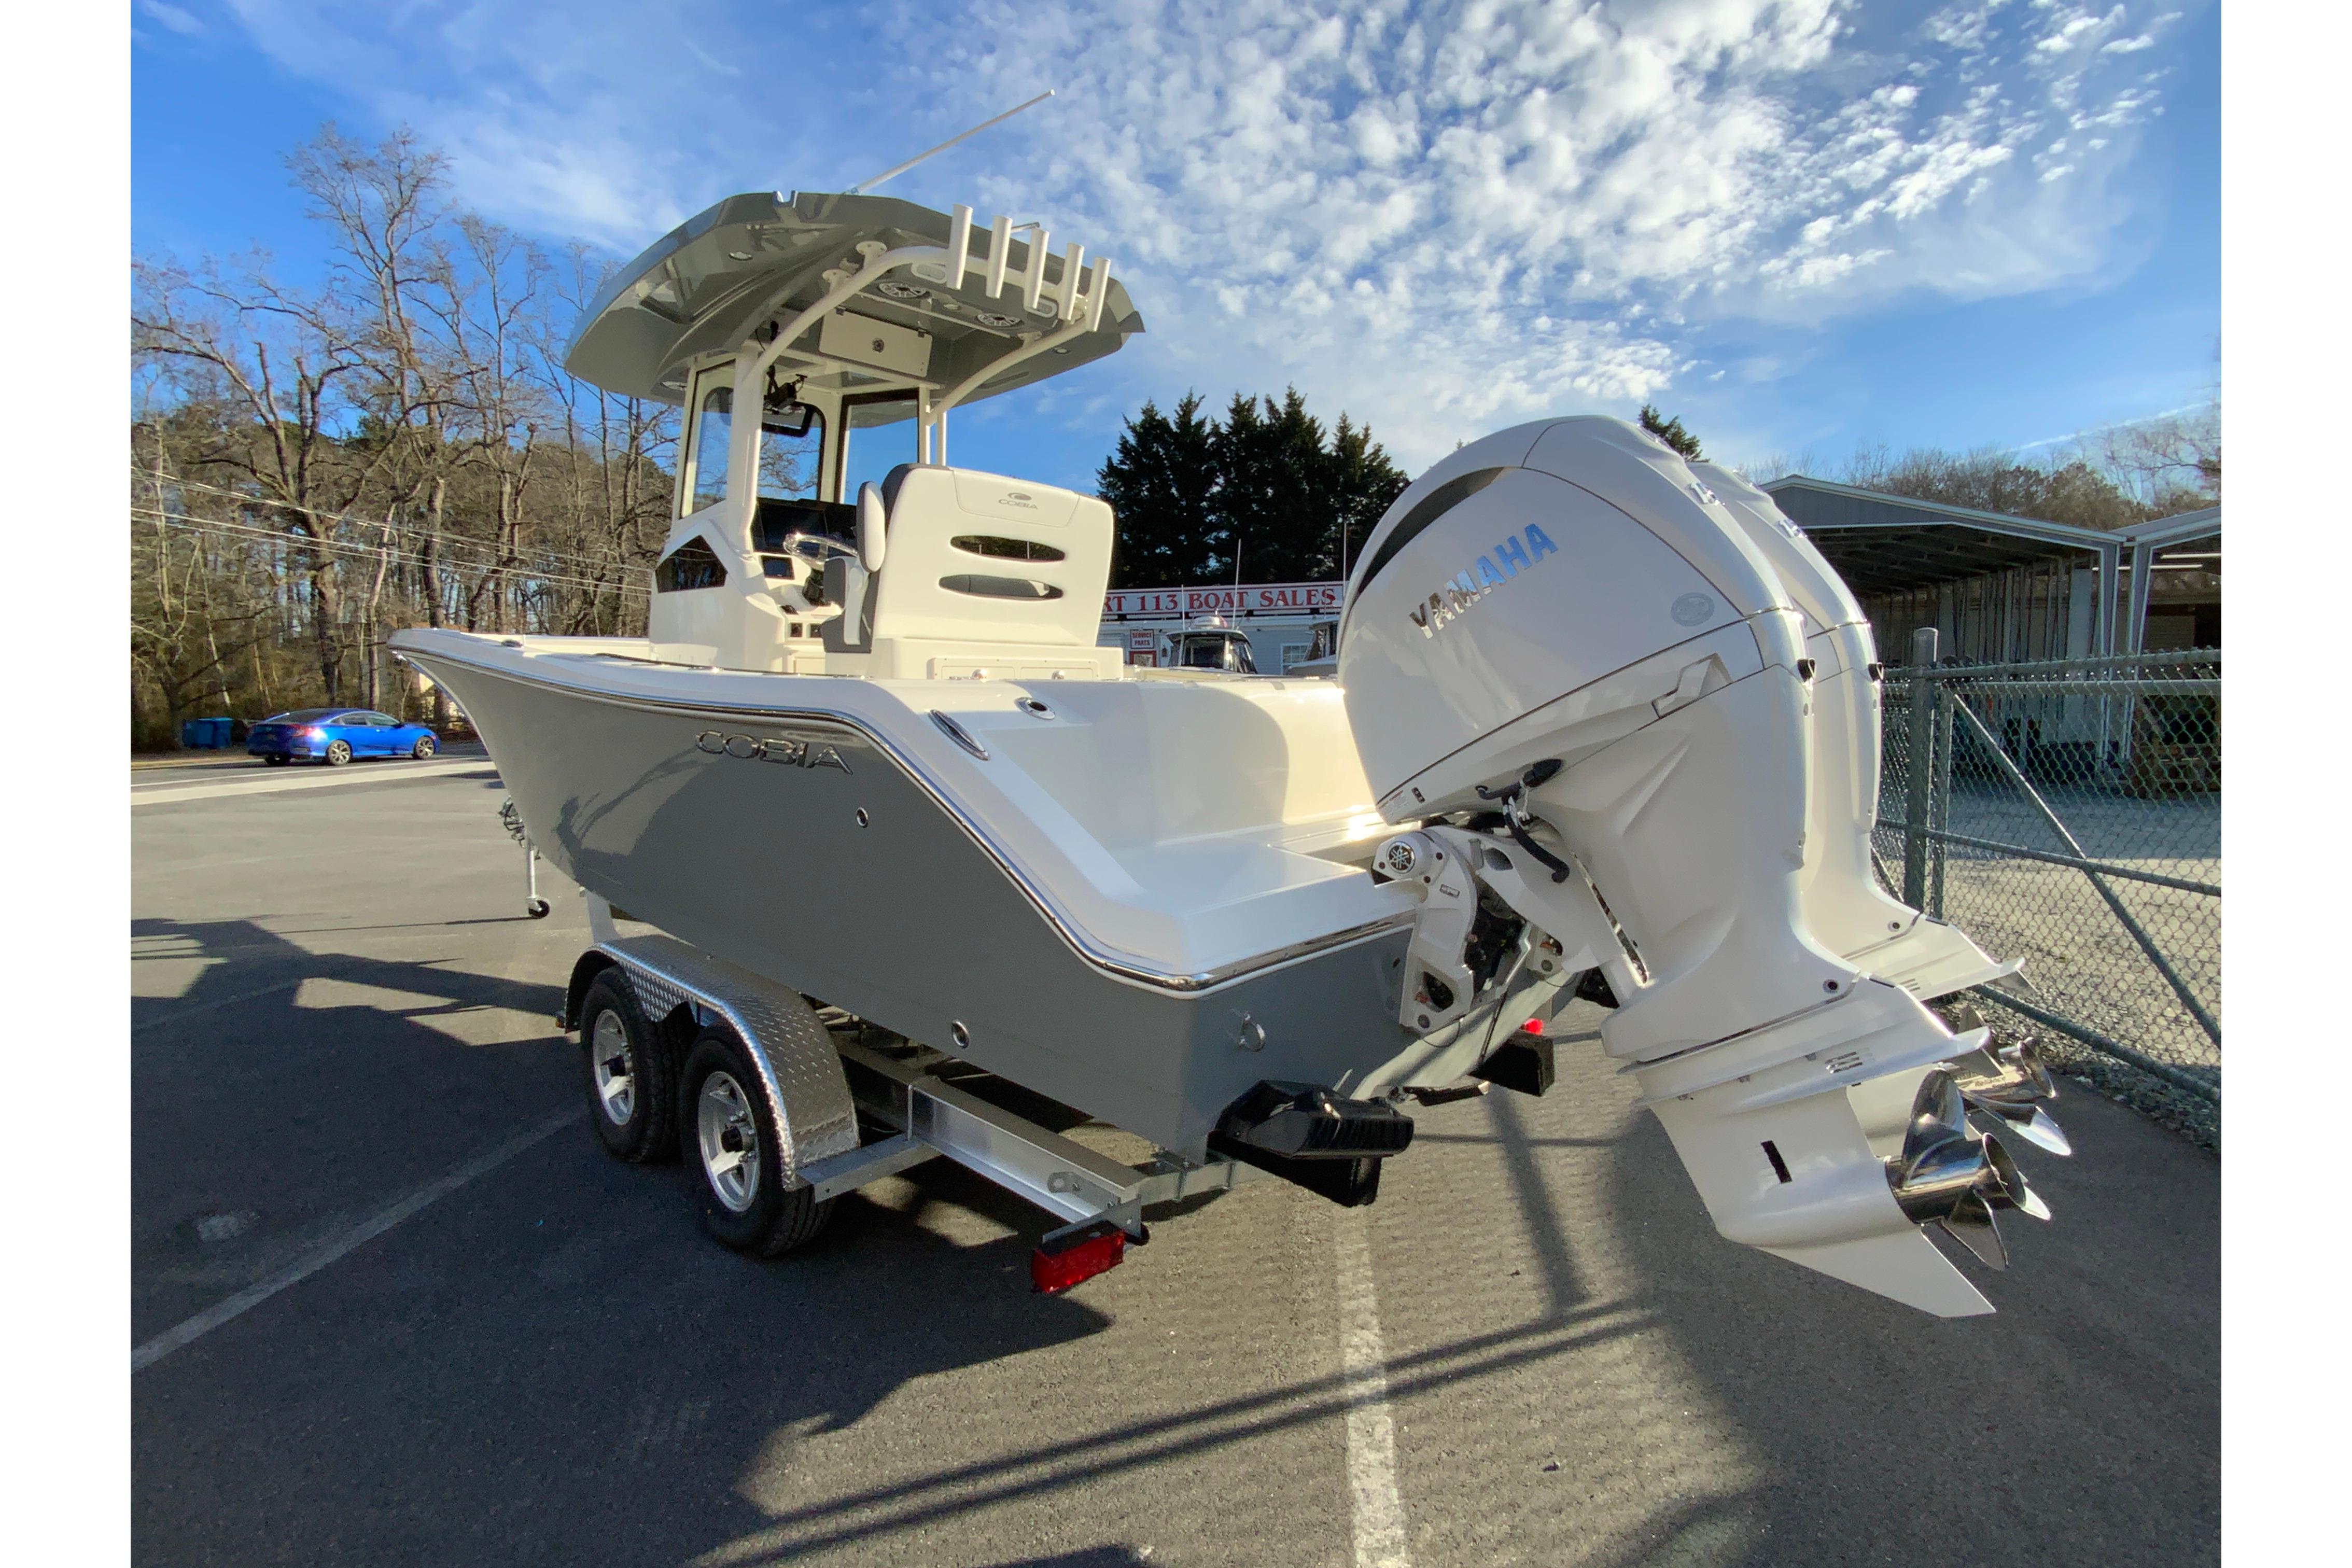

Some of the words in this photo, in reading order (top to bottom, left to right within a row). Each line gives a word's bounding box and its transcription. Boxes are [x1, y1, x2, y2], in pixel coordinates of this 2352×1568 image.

[999, 499, 1038, 510] COBIA
[1409, 523, 1558, 639] YAMAHA
[1137, 594, 1178, 611] 113
[1188, 591, 1249, 609] BOAT
[1260, 589, 1336, 607] SALES
[695, 730, 853, 775] COBIA
